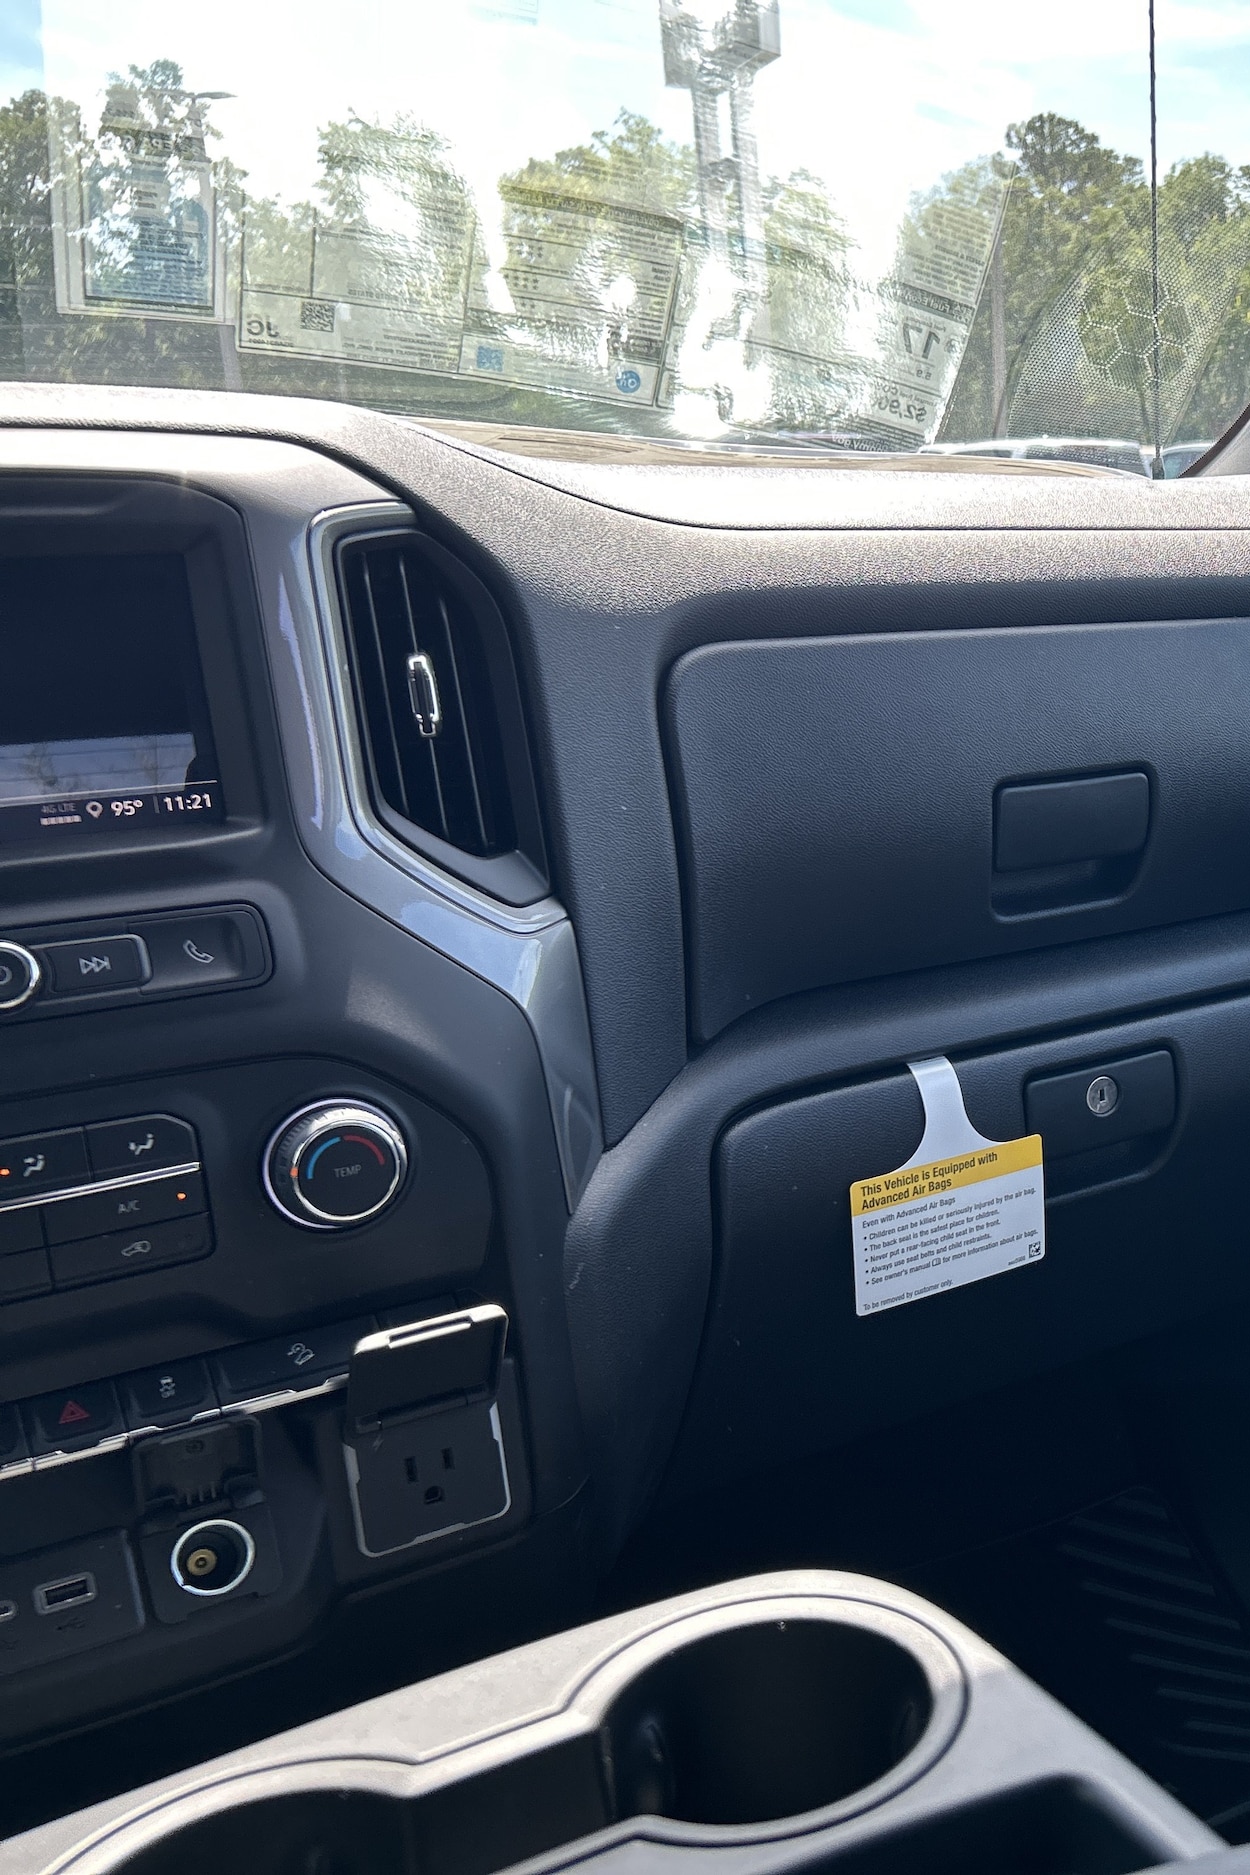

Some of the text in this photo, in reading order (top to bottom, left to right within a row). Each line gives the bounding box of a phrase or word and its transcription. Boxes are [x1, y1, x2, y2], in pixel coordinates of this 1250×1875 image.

[110, 793, 212, 816] 95° 11:21
[334, 1164, 362, 1179] TEMP
[861, 1152, 998, 1198] This Vehicle is Equipped with
[118, 1200, 141, 1214] A/C
[861, 1177, 952, 1211] Advanced Air Bags
[862, 1197, 956, 1229] Even with Advanced Air Bags
[869, 1228, 896, 1240] Children
[897, 1223, 909, 1232] can
[910, 1221, 918, 1229] be
[919, 1215, 937, 1226] killed
[946, 1206, 973, 1219] seriously
[974, 1198, 995, 1210] injured
[1004, 1194, 1014, 1202] the
[1015, 1190, 1023, 1198] air
[1023, 1187, 1036, 1196] bag.
[869, 1243, 881, 1252] The
[883, 1238, 897, 1248] back
[898, 1234, 912, 1243] seat
[912, 1231, 918, 1239] is
[919, 1228, 929, 1236] the
[930, 1223, 948, 1234] safest
[949, 1219, 965, 1230] place
[975, 1209, 1000, 1221] children.
[870, 1252, 888, 1263] Never
[889, 1248, 900, 1258] put
[906, 1237, 939, 1252] rear-facing
[940, 1232, 954, 1242] child
[955, 1228, 968, 1238] seat
[968, 1226, 974, 1234] in
[986, 1218, 1001, 1229] front.
[871, 1262, 893, 1274] Always
[894, 1259, 905, 1267] use
[906, 1254, 919, 1263] seat
[920, 1250, 935, 1259] belts
[936, 1246, 947, 1254] and
[948, 1241, 962, 1251] child
[871, 1276, 883, 1285] See
[884, 1269, 908, 1281] owner's
[909, 1261, 931, 1273] manual
[943, 1255, 951, 1263] for
[951, 1251, 967, 1261] more
[967, 1241, 999, 1256] information
[1000, 1235, 1015, 1246] about
[863, 1303, 871, 1311] To
[872, 1301, 879, 1309] be
[880, 1293, 905, 1307] removed
[906, 1291, 913, 1299] by
[914, 1282, 940, 1296] customer
